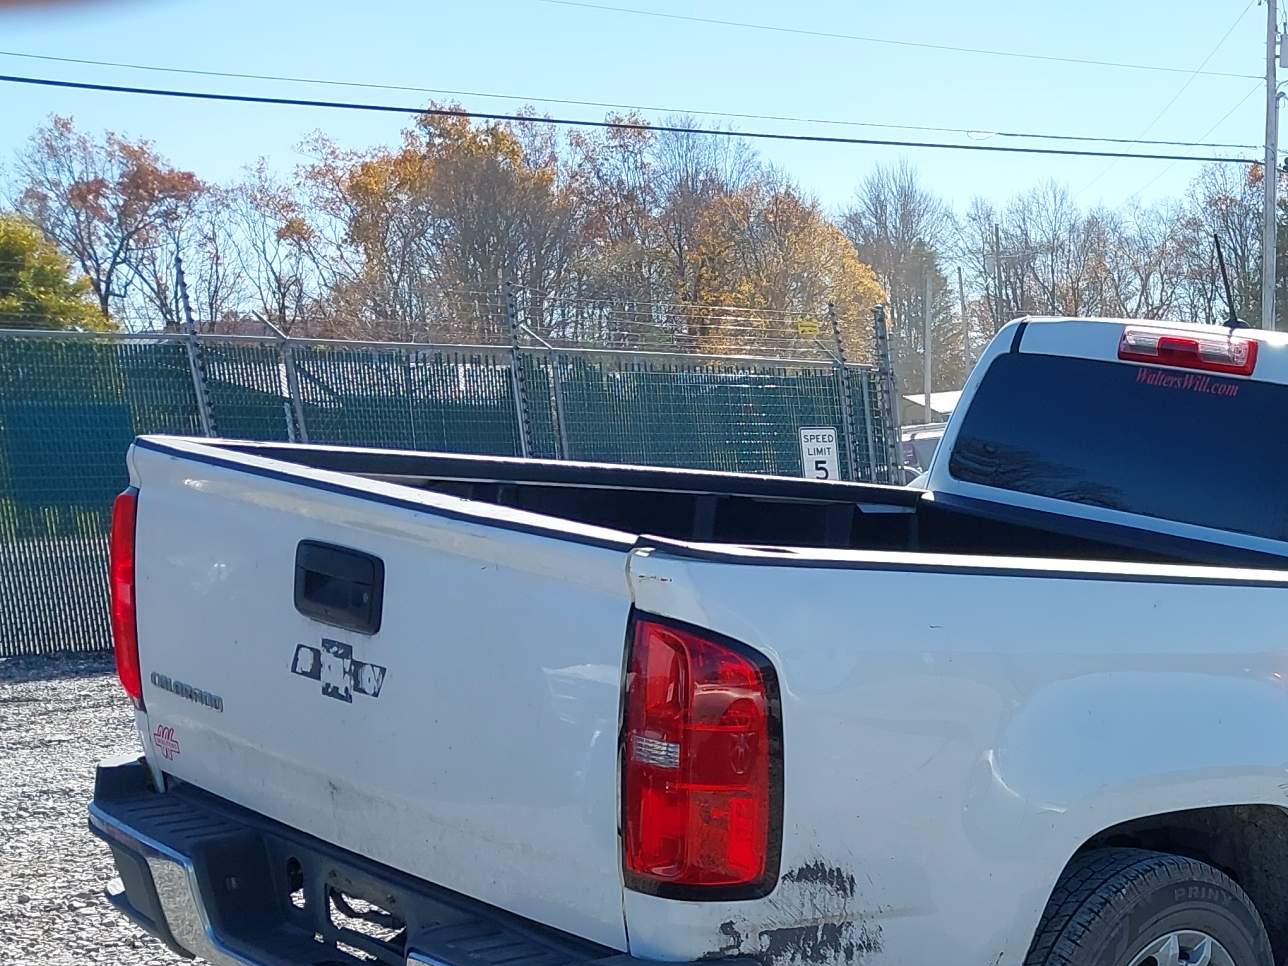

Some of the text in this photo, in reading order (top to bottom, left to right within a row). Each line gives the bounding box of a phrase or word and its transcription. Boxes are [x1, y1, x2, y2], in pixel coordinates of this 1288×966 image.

[1136, 367, 1239, 397] WaltersWill.com
[803, 434, 834, 443] SPEED
[807, 447, 831, 456] LIMIT
[814, 460, 829, 480] 5
